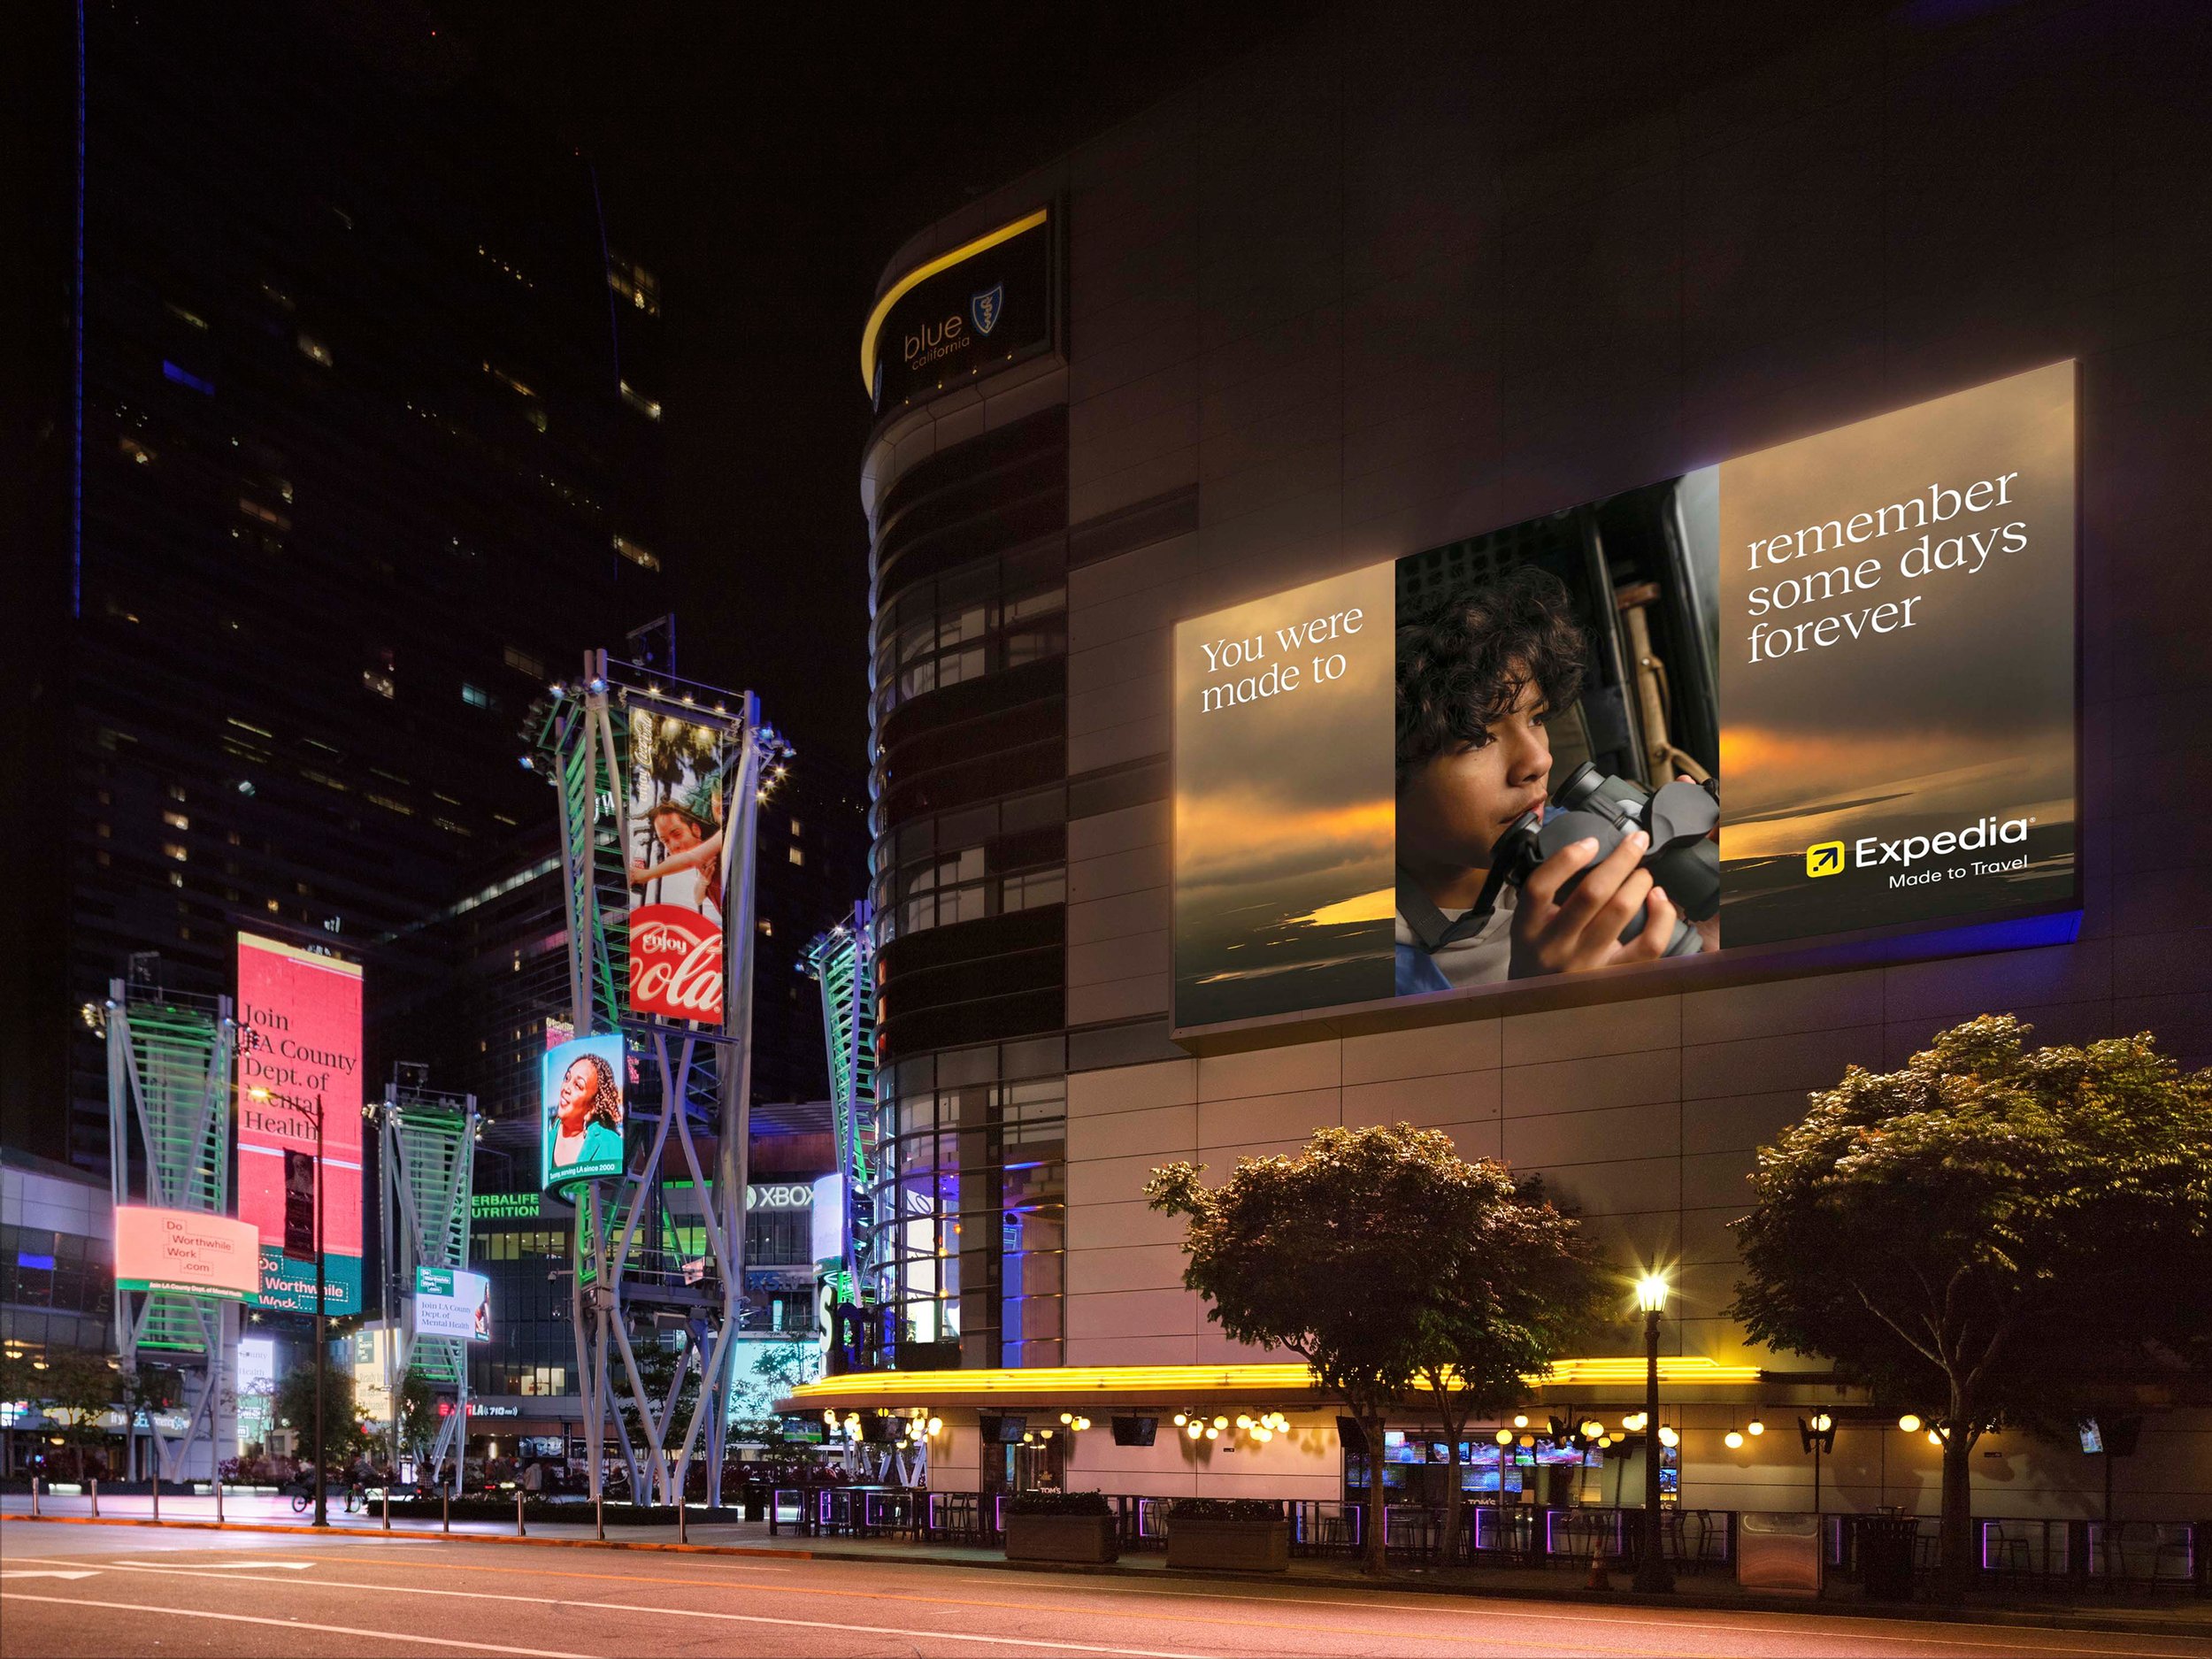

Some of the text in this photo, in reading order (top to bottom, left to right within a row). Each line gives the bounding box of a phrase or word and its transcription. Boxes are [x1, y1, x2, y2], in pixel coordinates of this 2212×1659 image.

[904, 316, 963, 362] blue
[912, 336, 970, 371] california
[1747, 472, 2018, 572] remember
[1747, 521, 2028, 617] some days
[1200, 608, 1363, 673] You were
[1747, 595, 1922, 664] forever
[1201, 654, 1347, 714] made to
[1889, 855, 2028, 889] Made to Travel
[244, 1003, 288, 1031] Join
[280, 1040, 357, 1075] County
[244, 1058, 330, 1092] Dept. of
[244, 1110, 319, 1141] Health
[576, 1165, 584, 1174] LA
[471, 1194, 539, 1207] ERBALIFE
[471, 1205, 540, 1218] UTRITION
[166, 1221, 182, 1232] Do
[167, 1248, 196, 1258] Work
[173, 1234, 232, 1251] Worthwhile
[183, 1262, 210, 1272] .com
[170, 1283, 192, 1292] County
[421, 1318, 448, 1327] Mental
[449, 1304, 471, 1313] County
